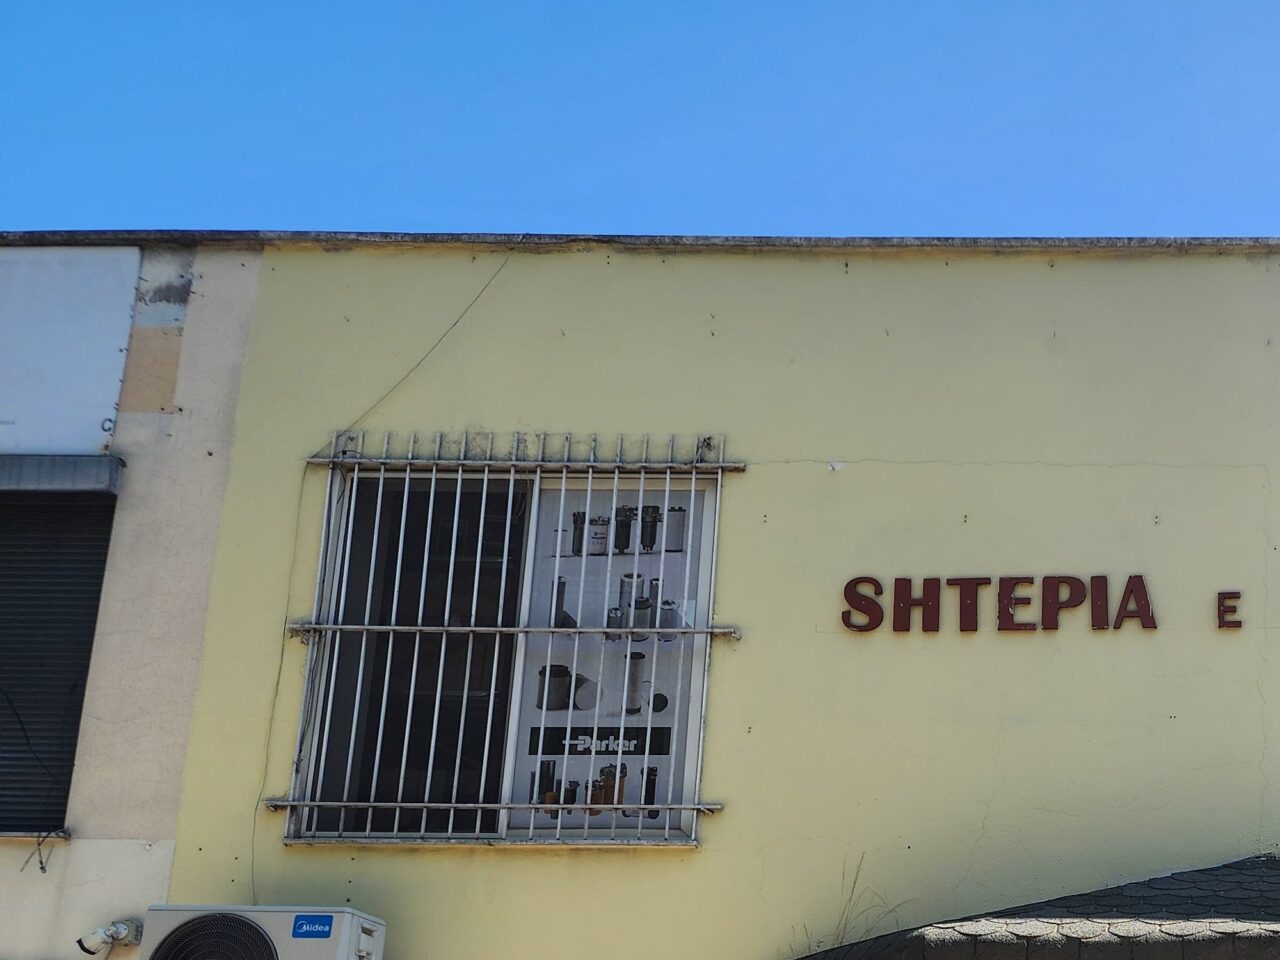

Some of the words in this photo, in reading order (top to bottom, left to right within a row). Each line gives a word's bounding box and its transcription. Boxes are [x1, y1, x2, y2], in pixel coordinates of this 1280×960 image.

[841, 574, 1157, 632] SHTEPIA
[1218, 591, 1242, 629] E
[577, 736, 637, 751] Parker
[299, 924, 329, 932] Midea
